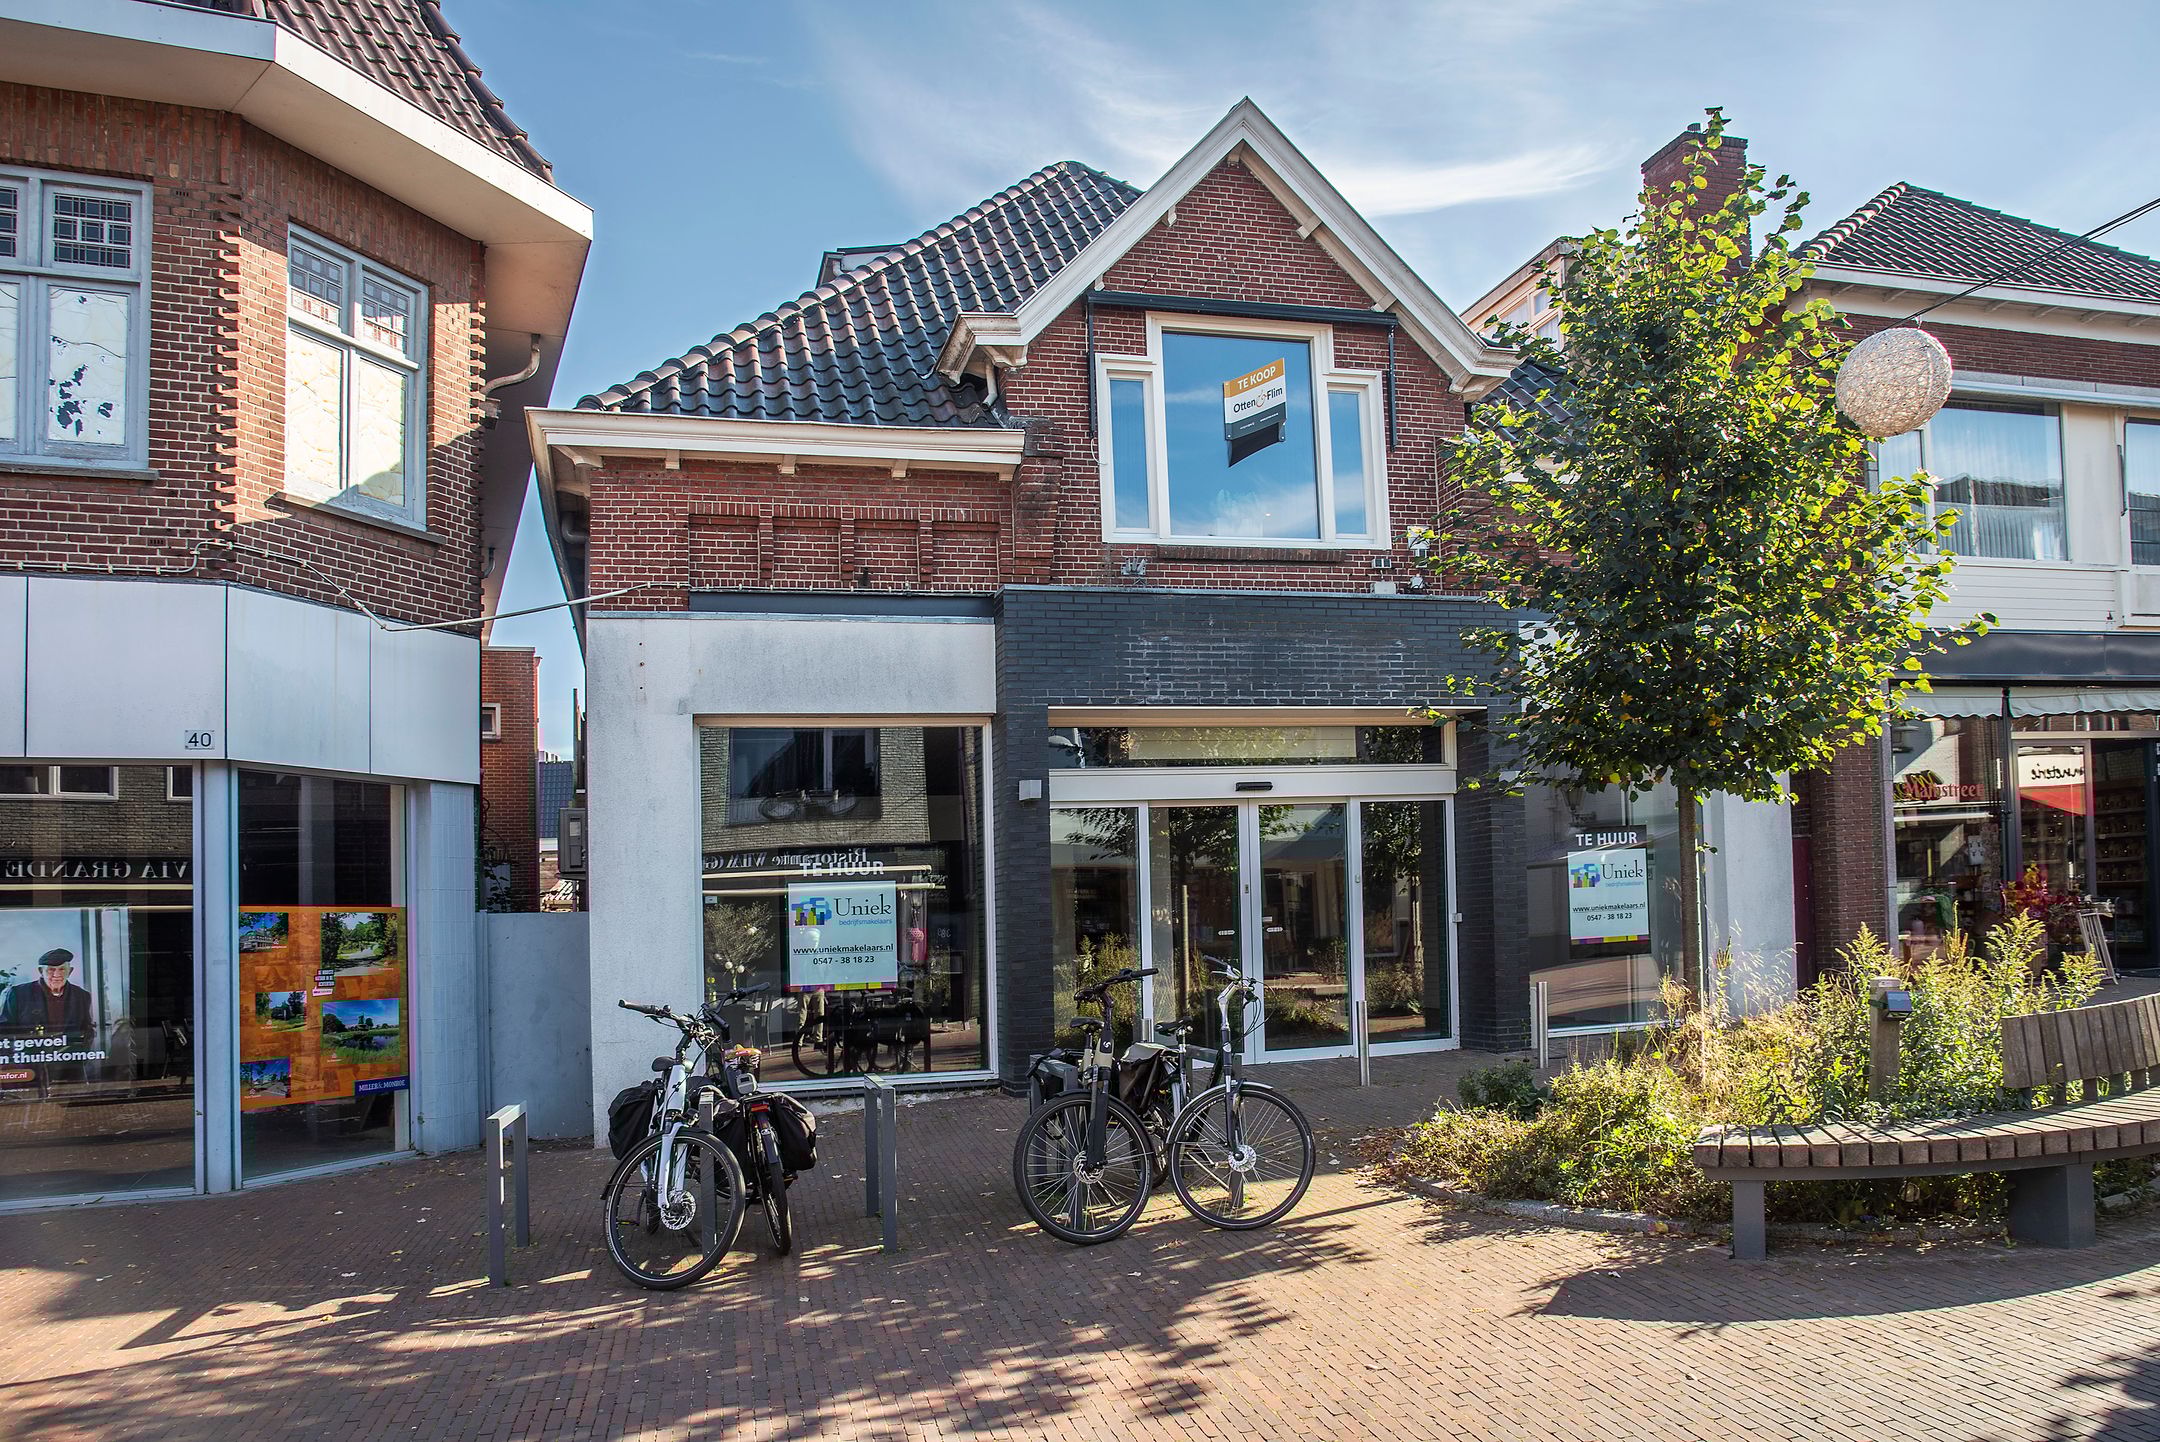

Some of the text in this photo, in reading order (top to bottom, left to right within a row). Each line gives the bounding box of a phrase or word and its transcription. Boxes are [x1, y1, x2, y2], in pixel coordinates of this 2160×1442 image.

[1237, 366, 1276, 390] TE KOOP
[1233, 399, 1256, 413] Otten
[1267, 387, 1283, 400] Flim
[188, 732, 212, 747] 40
[1903, 783, 1984, 799] Mainstreet
[1575, 831, 1638, 846] TE HUUR
[800, 861, 884, 877] TE HUUR
[1601, 859, 1644, 880] Uniek
[834, 894, 892, 916] Uniek
[1572, 901, 1646, 912] www.uniekmakelaars.nl
[1586, 914, 1602, 922] 0547
[793, 943, 894, 954] www.uniekmakelaars.nl
[813, 957, 833, 965] 0547
[840, 956, 851, 964] 38
[854, 956, 863, 964] 18
[864, 955, 875, 963] 23
[14, 1035, 67, 1051] gevoel
[13, 1050, 106, 1064] thuiskomen
